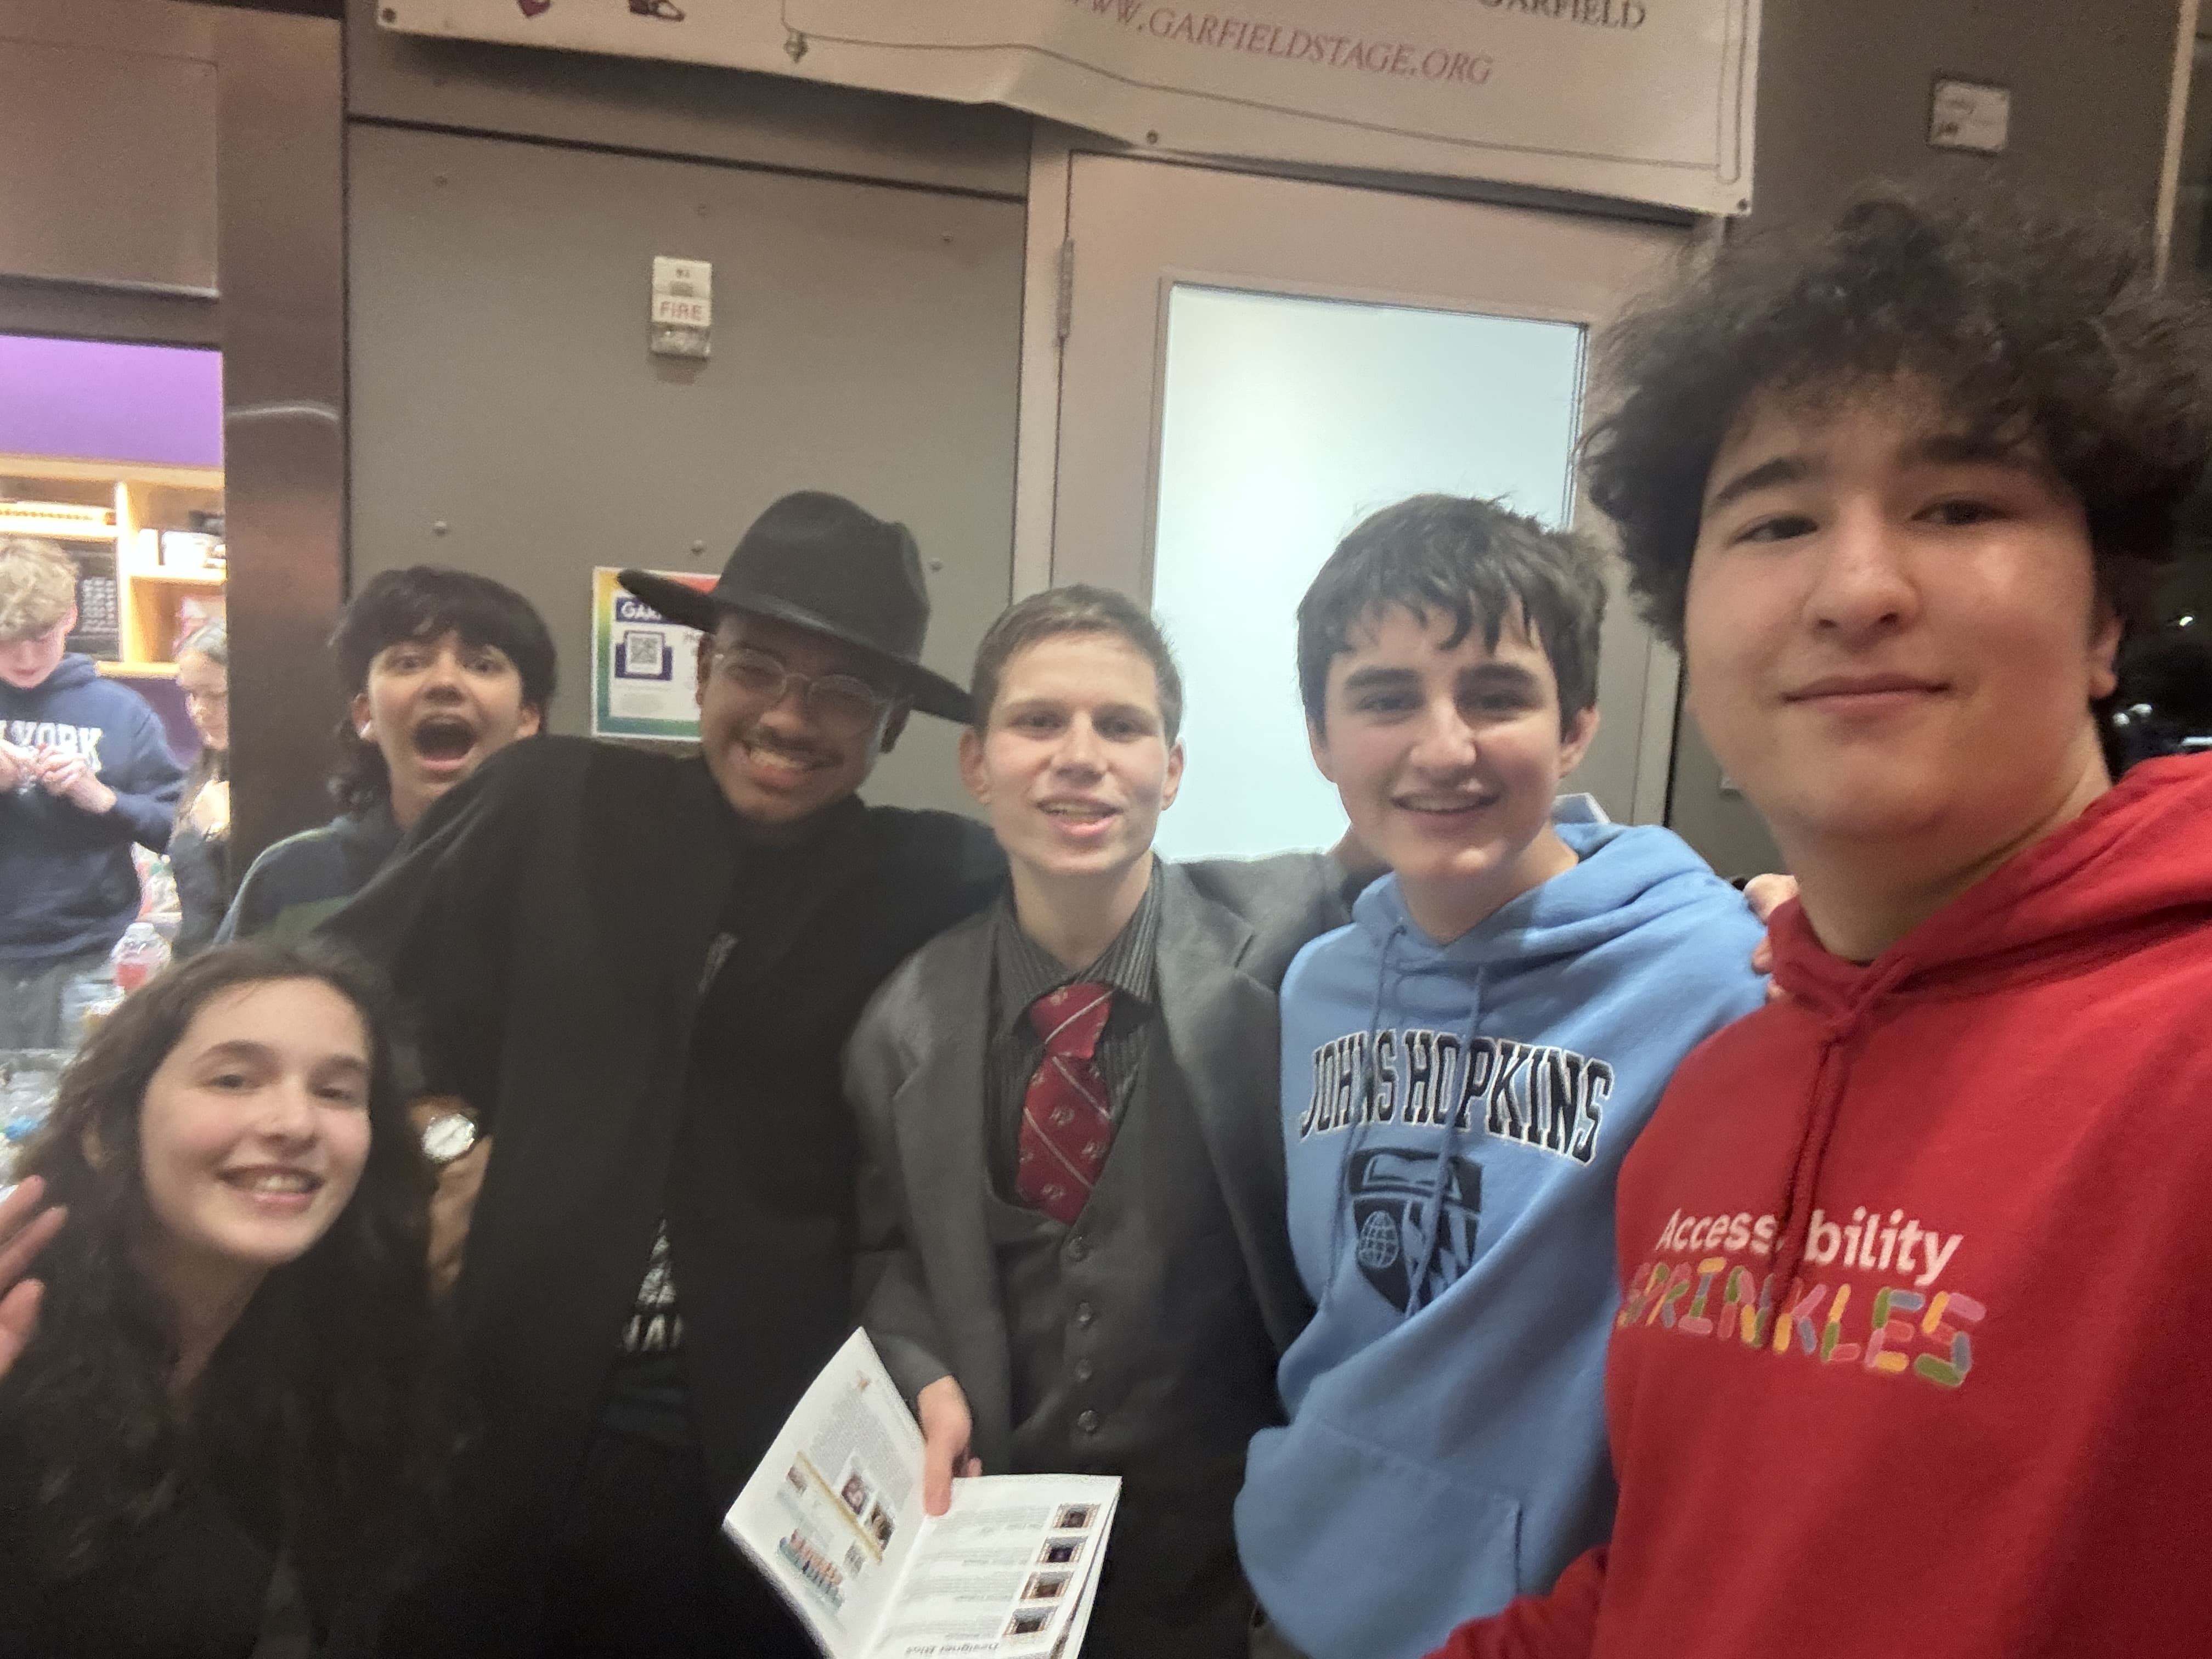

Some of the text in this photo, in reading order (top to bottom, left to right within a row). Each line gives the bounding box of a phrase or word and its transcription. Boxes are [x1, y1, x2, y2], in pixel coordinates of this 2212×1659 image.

[1070, 0, 1493, 86] WW.GARFIELDSTAGE.ORG
[659, 301, 703, 321] FIRE
[1402, 1029, 1614, 1167] HOPKINS
[1655, 1206, 1963, 1286] Accessbility
